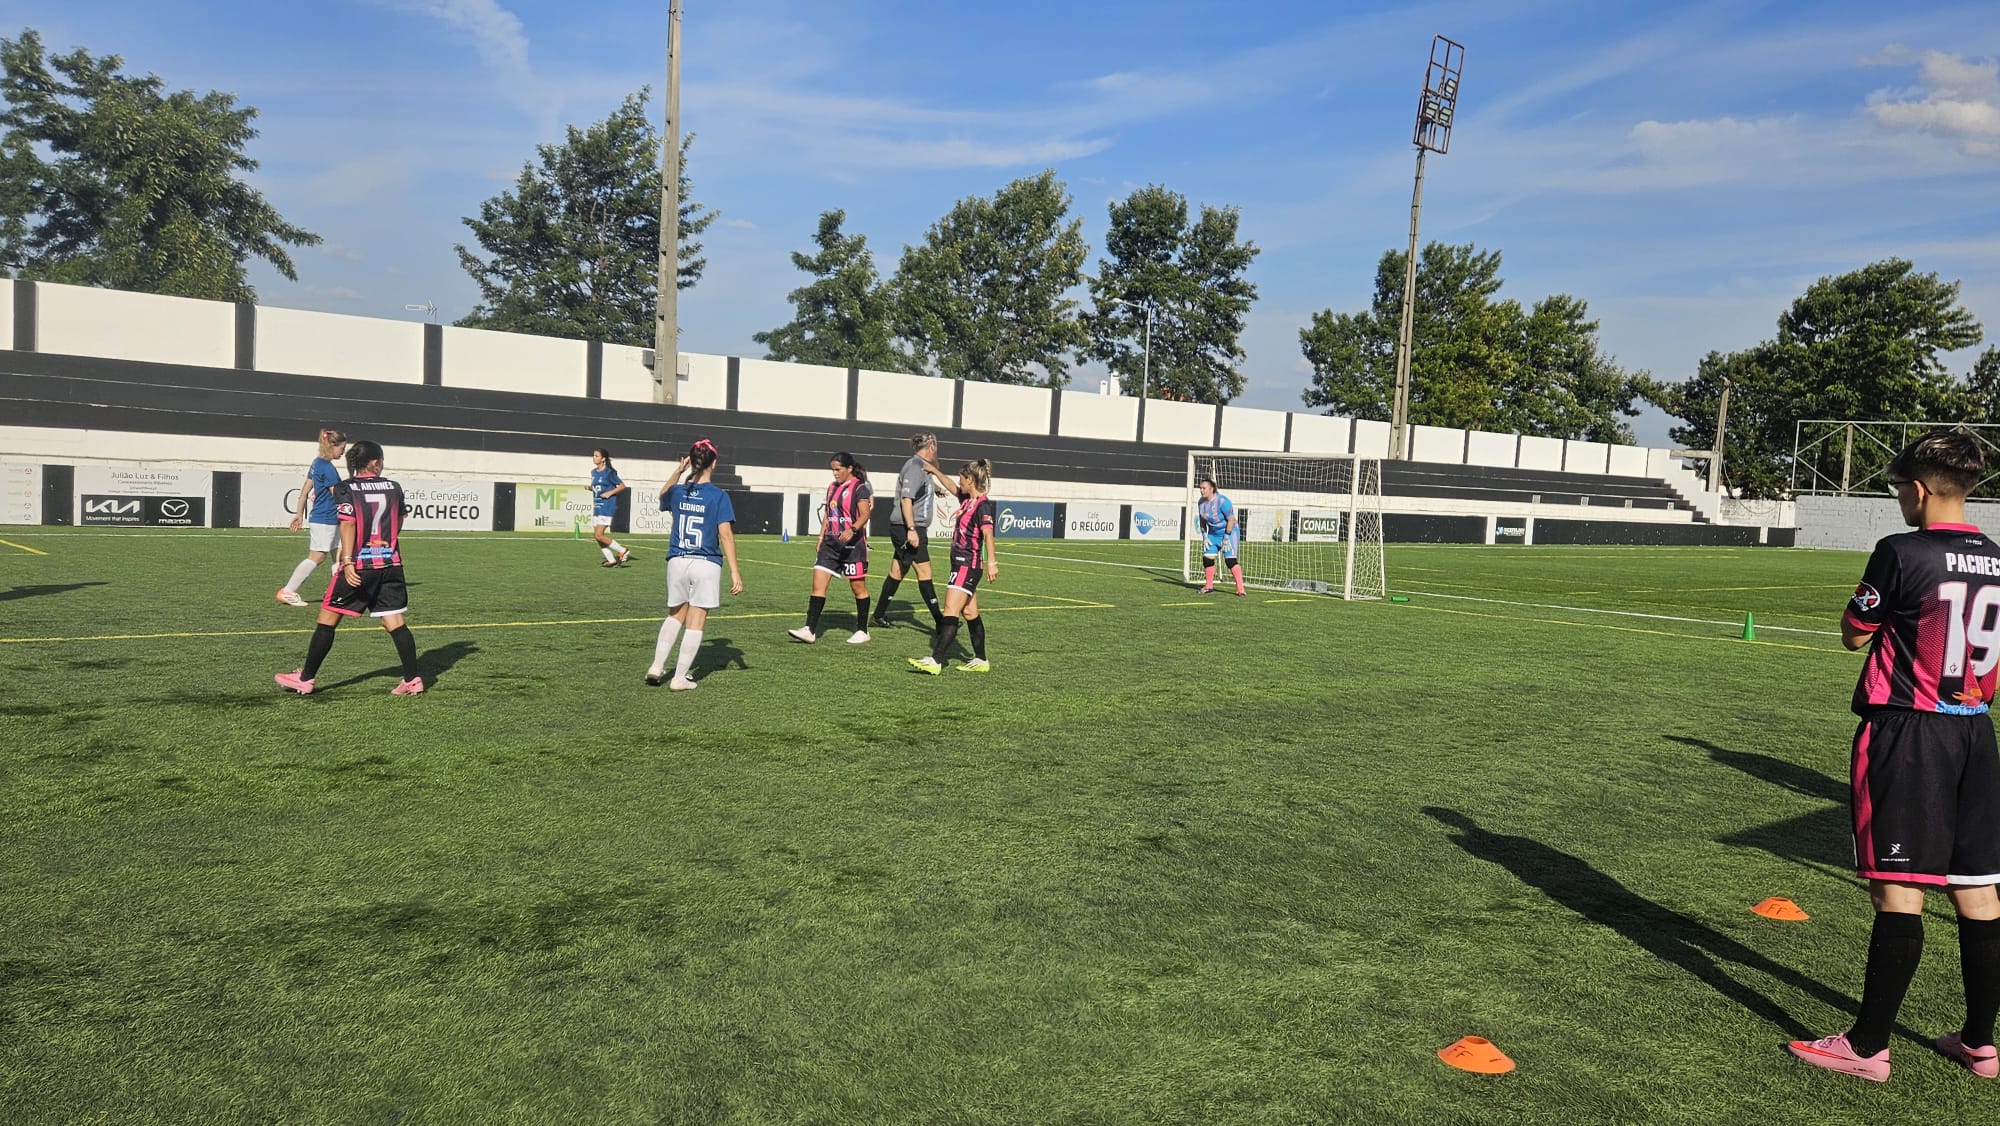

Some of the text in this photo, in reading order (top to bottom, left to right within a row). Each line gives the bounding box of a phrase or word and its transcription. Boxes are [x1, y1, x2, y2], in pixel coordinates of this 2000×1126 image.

[349, 481, 395, 491] M. ANTUNES
[404, 489, 479, 503] Café, Cervejaria
[536, 488, 568, 511] MF
[637, 491, 660, 504] Hote
[405, 504, 480, 520] PACHECO
[565, 501, 592, 512] Grupo
[640, 504, 660, 517] dos
[679, 502, 705, 513] LEONOR
[364, 493, 387, 535] 7
[635, 517, 671, 529] Cavale
[1002, 514, 1052, 530] Projectiva
[1071, 519, 1115, 532] O RELÓGIO
[1303, 519, 1335, 532] CONALS
[678, 514, 705, 550] 15
[935, 530, 954, 538] LOGI
[844, 563, 856, 575] 28
[1945, 552, 2000, 577] PACHEC
[1938, 581, 2000, 677] 19
